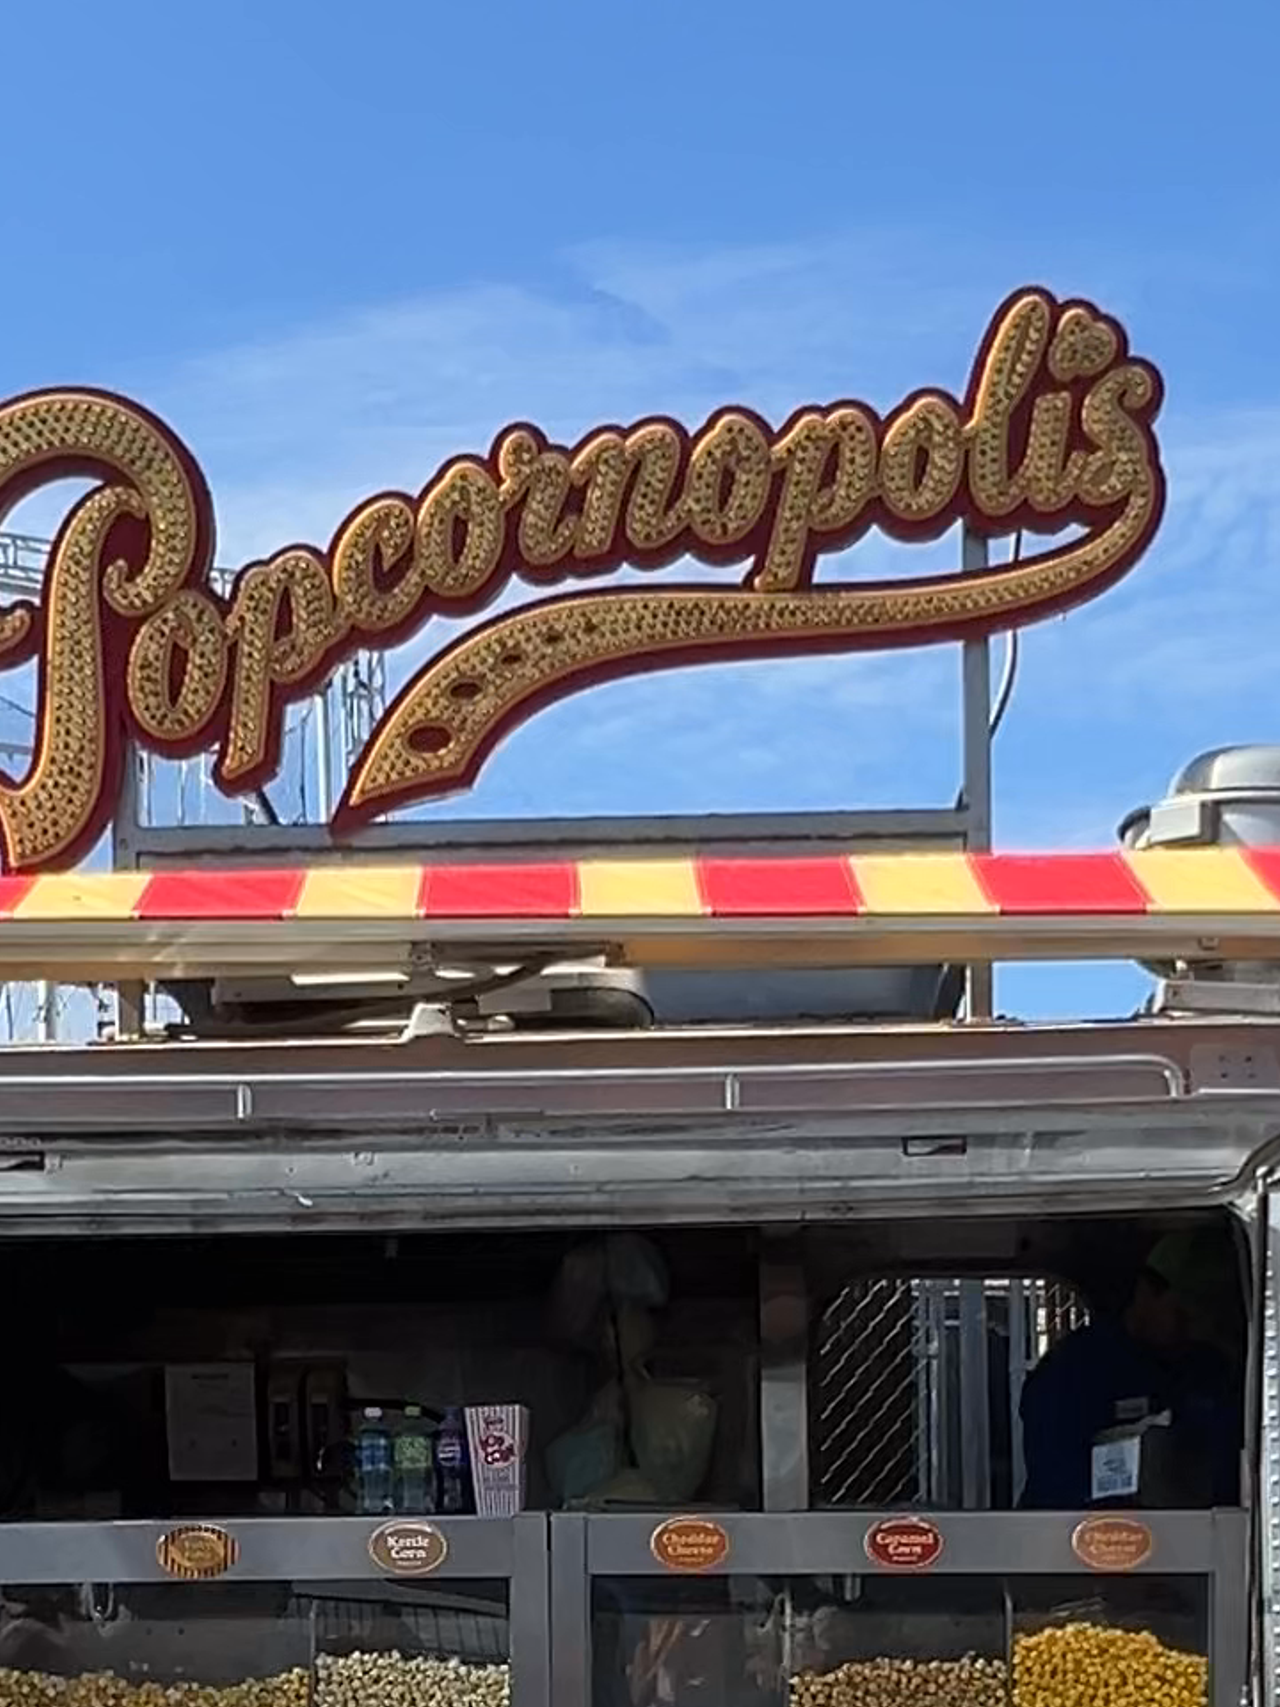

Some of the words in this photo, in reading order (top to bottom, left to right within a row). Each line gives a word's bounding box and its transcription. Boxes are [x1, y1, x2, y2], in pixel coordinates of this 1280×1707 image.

[387, 1535, 430, 1548] Kettle
[662, 1532, 719, 1546] Cheddar
[876, 1532, 934, 1545] Caramel
[390, 1547, 426, 1560] Corn
[667, 1545, 714, 1556] Cheese
[887, 1544, 922, 1556] Corn
